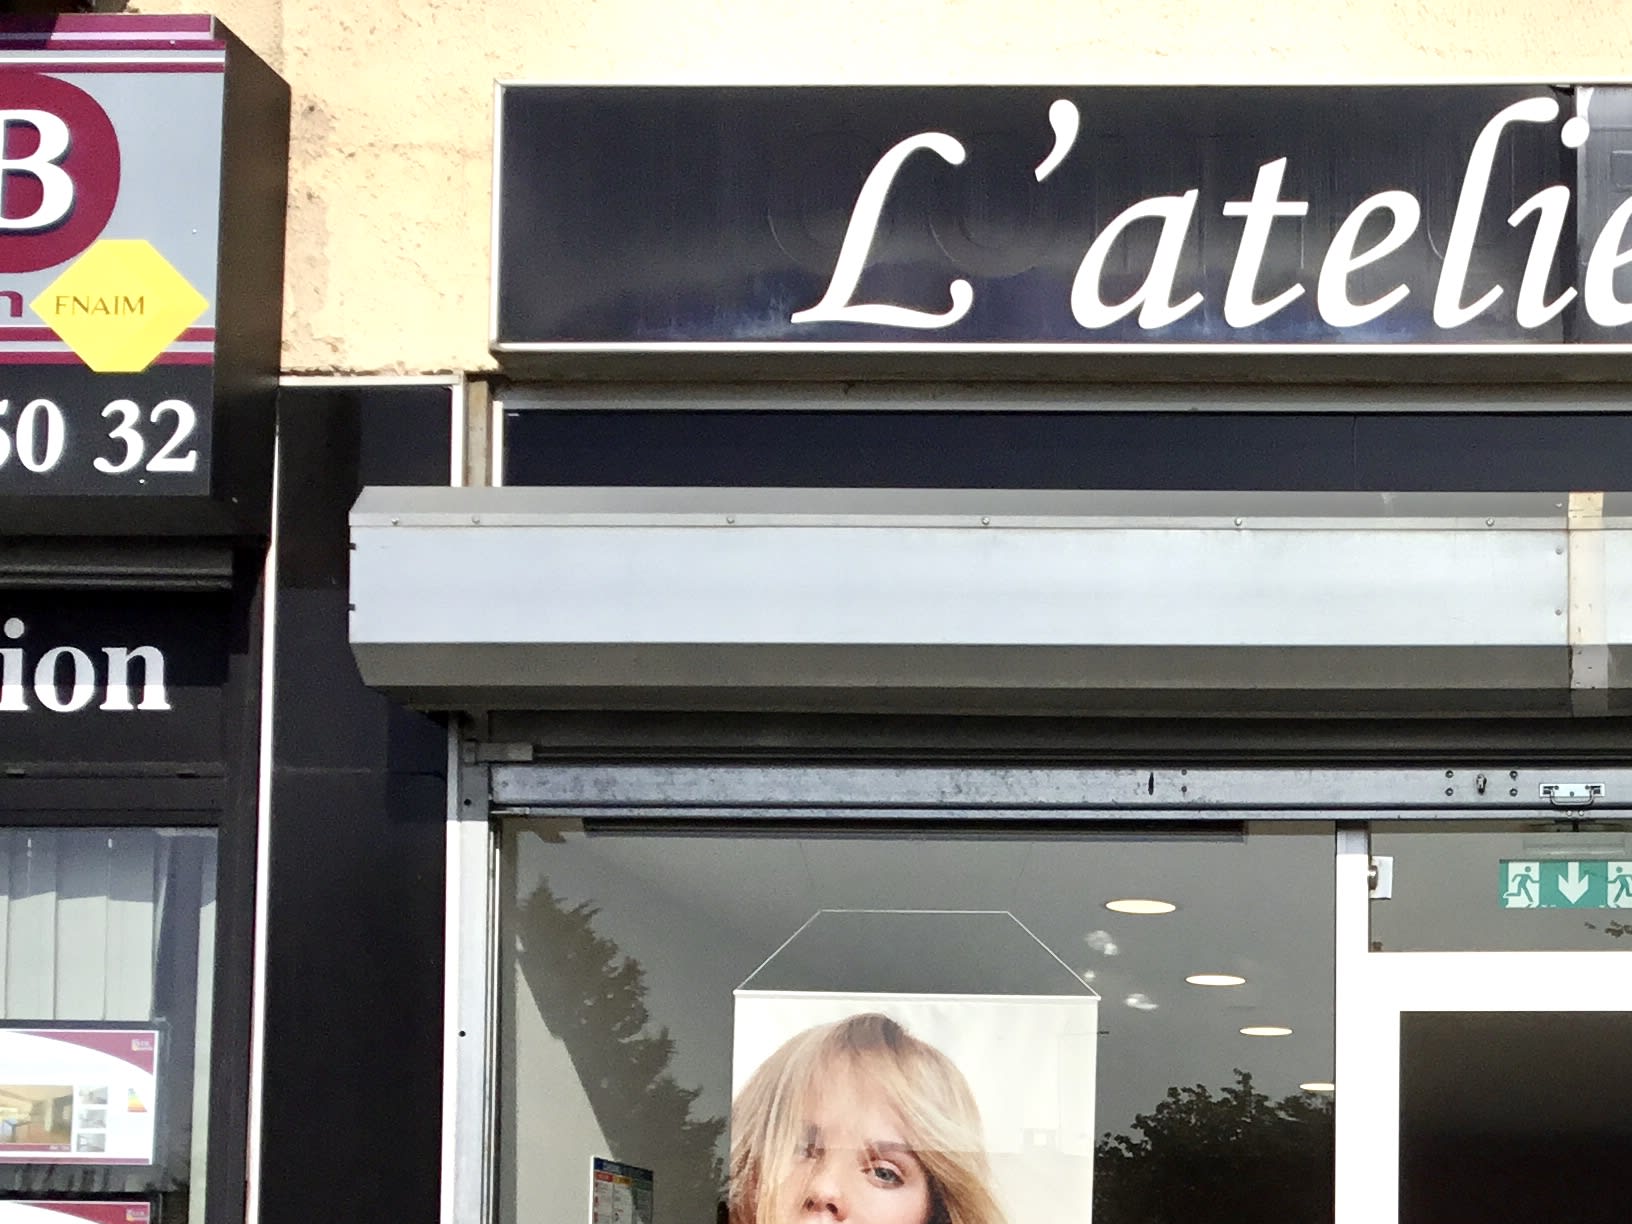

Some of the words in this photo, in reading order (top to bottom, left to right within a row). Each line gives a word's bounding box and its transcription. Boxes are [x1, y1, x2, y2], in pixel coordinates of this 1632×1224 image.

[55, 295, 144, 316] FNAIM
[0, 399, 65, 473] 0
[93, 399, 197, 473] 32
